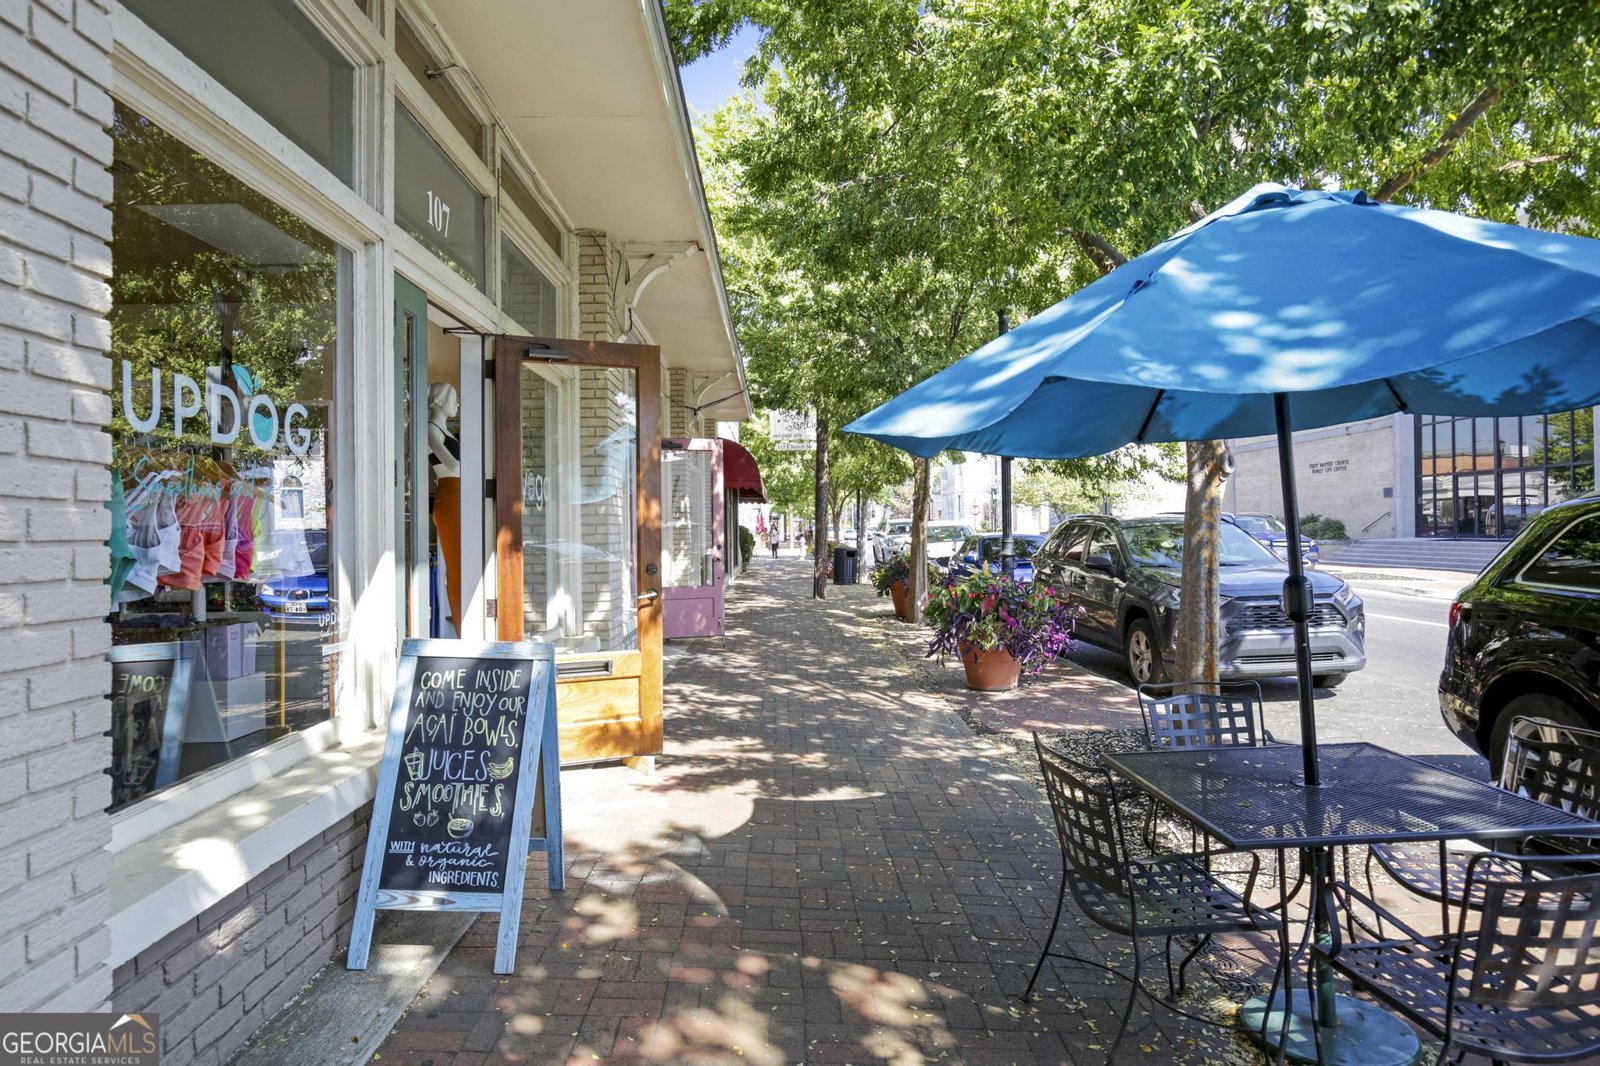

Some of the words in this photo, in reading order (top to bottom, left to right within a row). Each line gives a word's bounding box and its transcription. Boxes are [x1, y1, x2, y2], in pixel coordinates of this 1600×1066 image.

[427, 190, 450, 238] 107
[122, 359, 312, 456] UPDOG
[420, 669, 467, 690] COME
[475, 668, 522, 693] INSIDE
[414, 691, 445, 709] AND
[452, 690, 498, 717] ENJOY
[462, 715, 519, 748] BOWLS,
[400, 781, 505, 818] SMOOTHIES,
[389, 840, 415, 854] WITH
[420, 841, 499, 857] natural
[405, 854, 415, 866] &
[418, 856, 494, 871] organic
